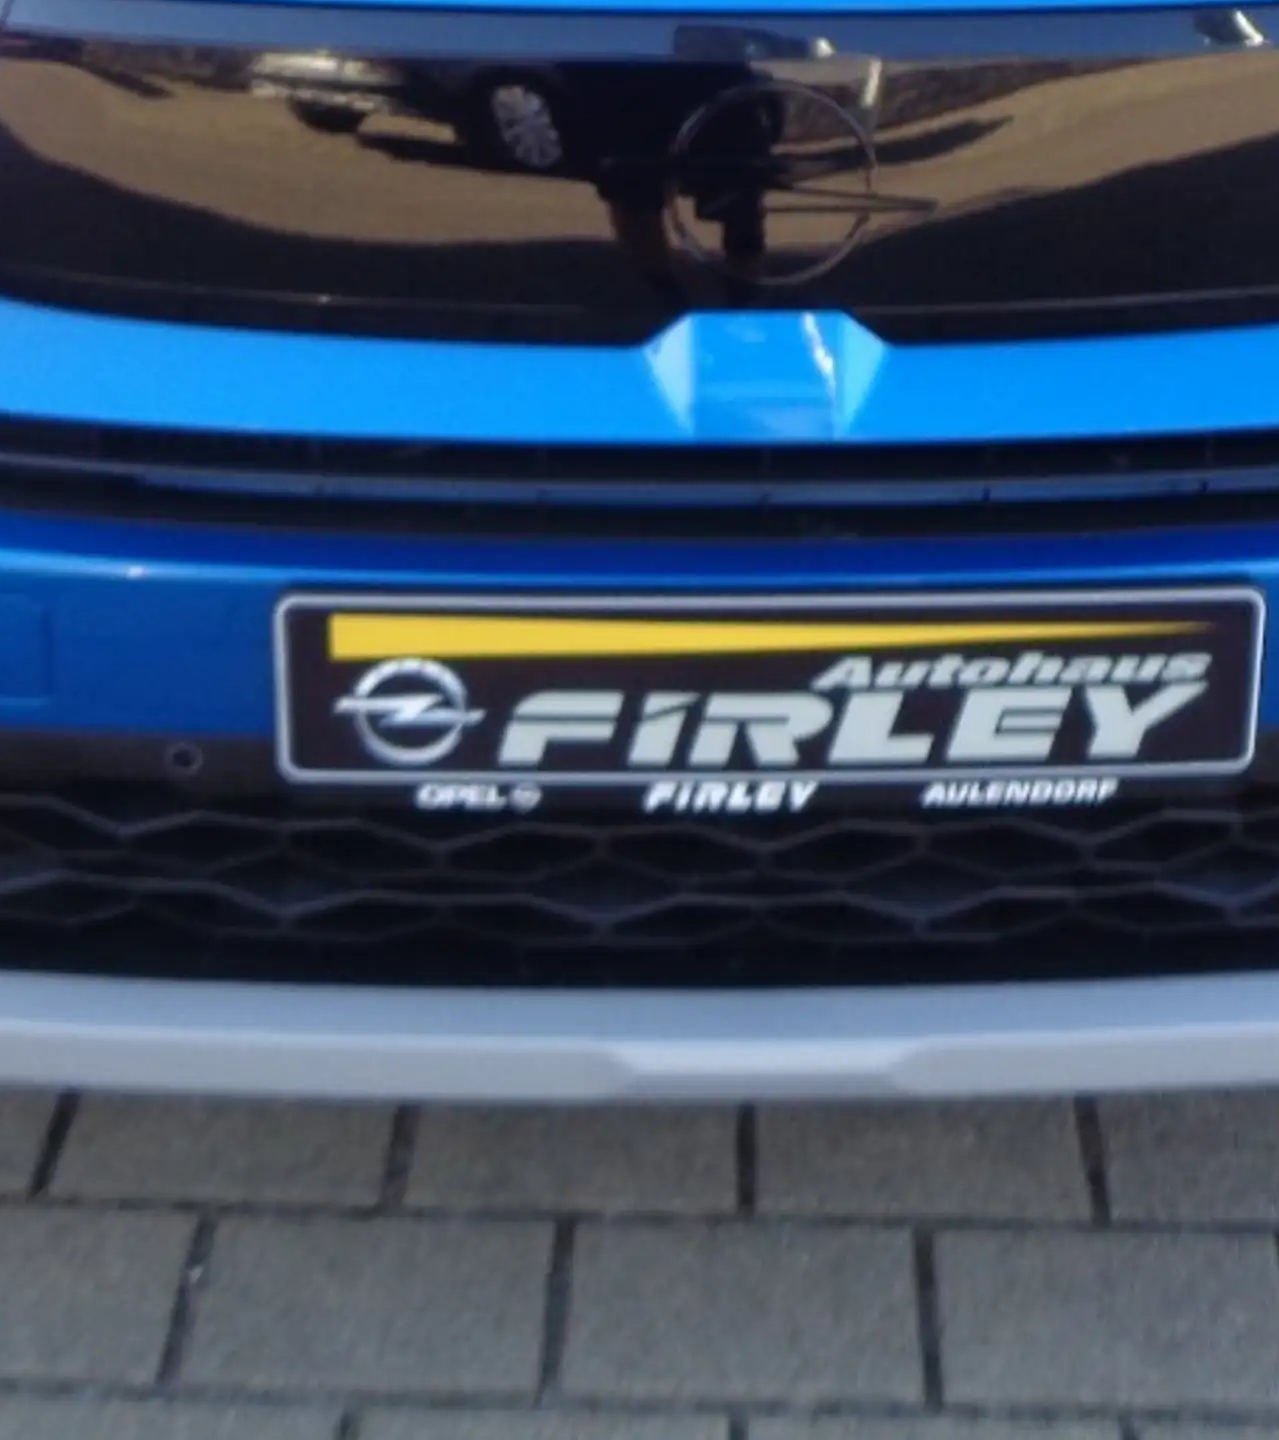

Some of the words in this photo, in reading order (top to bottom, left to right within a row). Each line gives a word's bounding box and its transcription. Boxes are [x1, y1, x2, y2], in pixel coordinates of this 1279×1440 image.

[811, 652, 1213, 691] Autohaus
[497, 681, 1209, 767] FIRLEY
[416, 782, 508, 810] OPEL
[643, 779, 819, 814] FIRLEY
[922, 776, 1119, 809] AULENDORF
